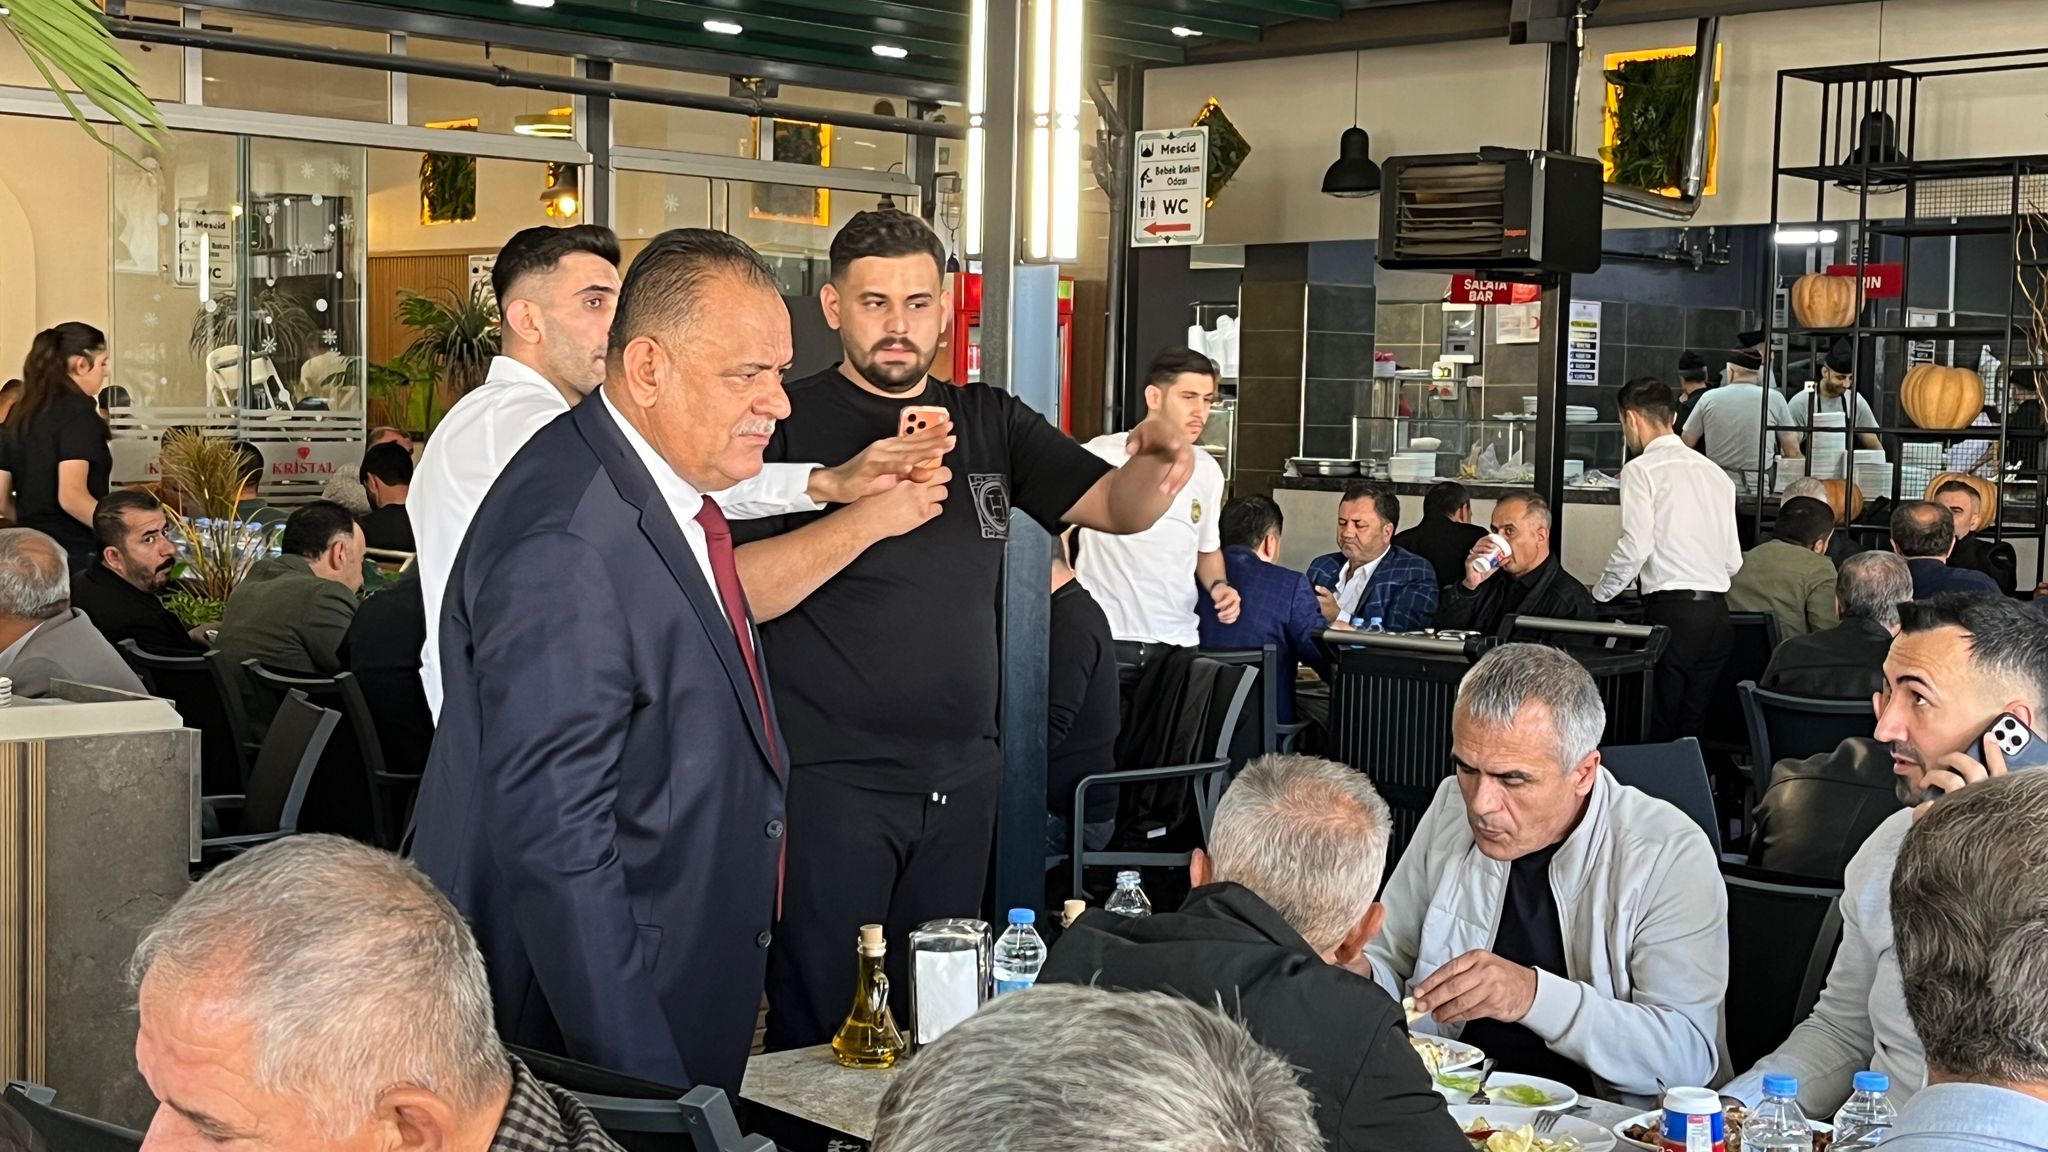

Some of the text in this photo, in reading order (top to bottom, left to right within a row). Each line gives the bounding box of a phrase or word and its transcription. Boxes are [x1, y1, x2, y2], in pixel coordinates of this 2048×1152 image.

[1161, 142, 1196, 155] Mescid
[1155, 165, 1176, 176] Bebek
[1163, 199, 1189, 215] WC
[1468, 291, 1494, 302] BAR
